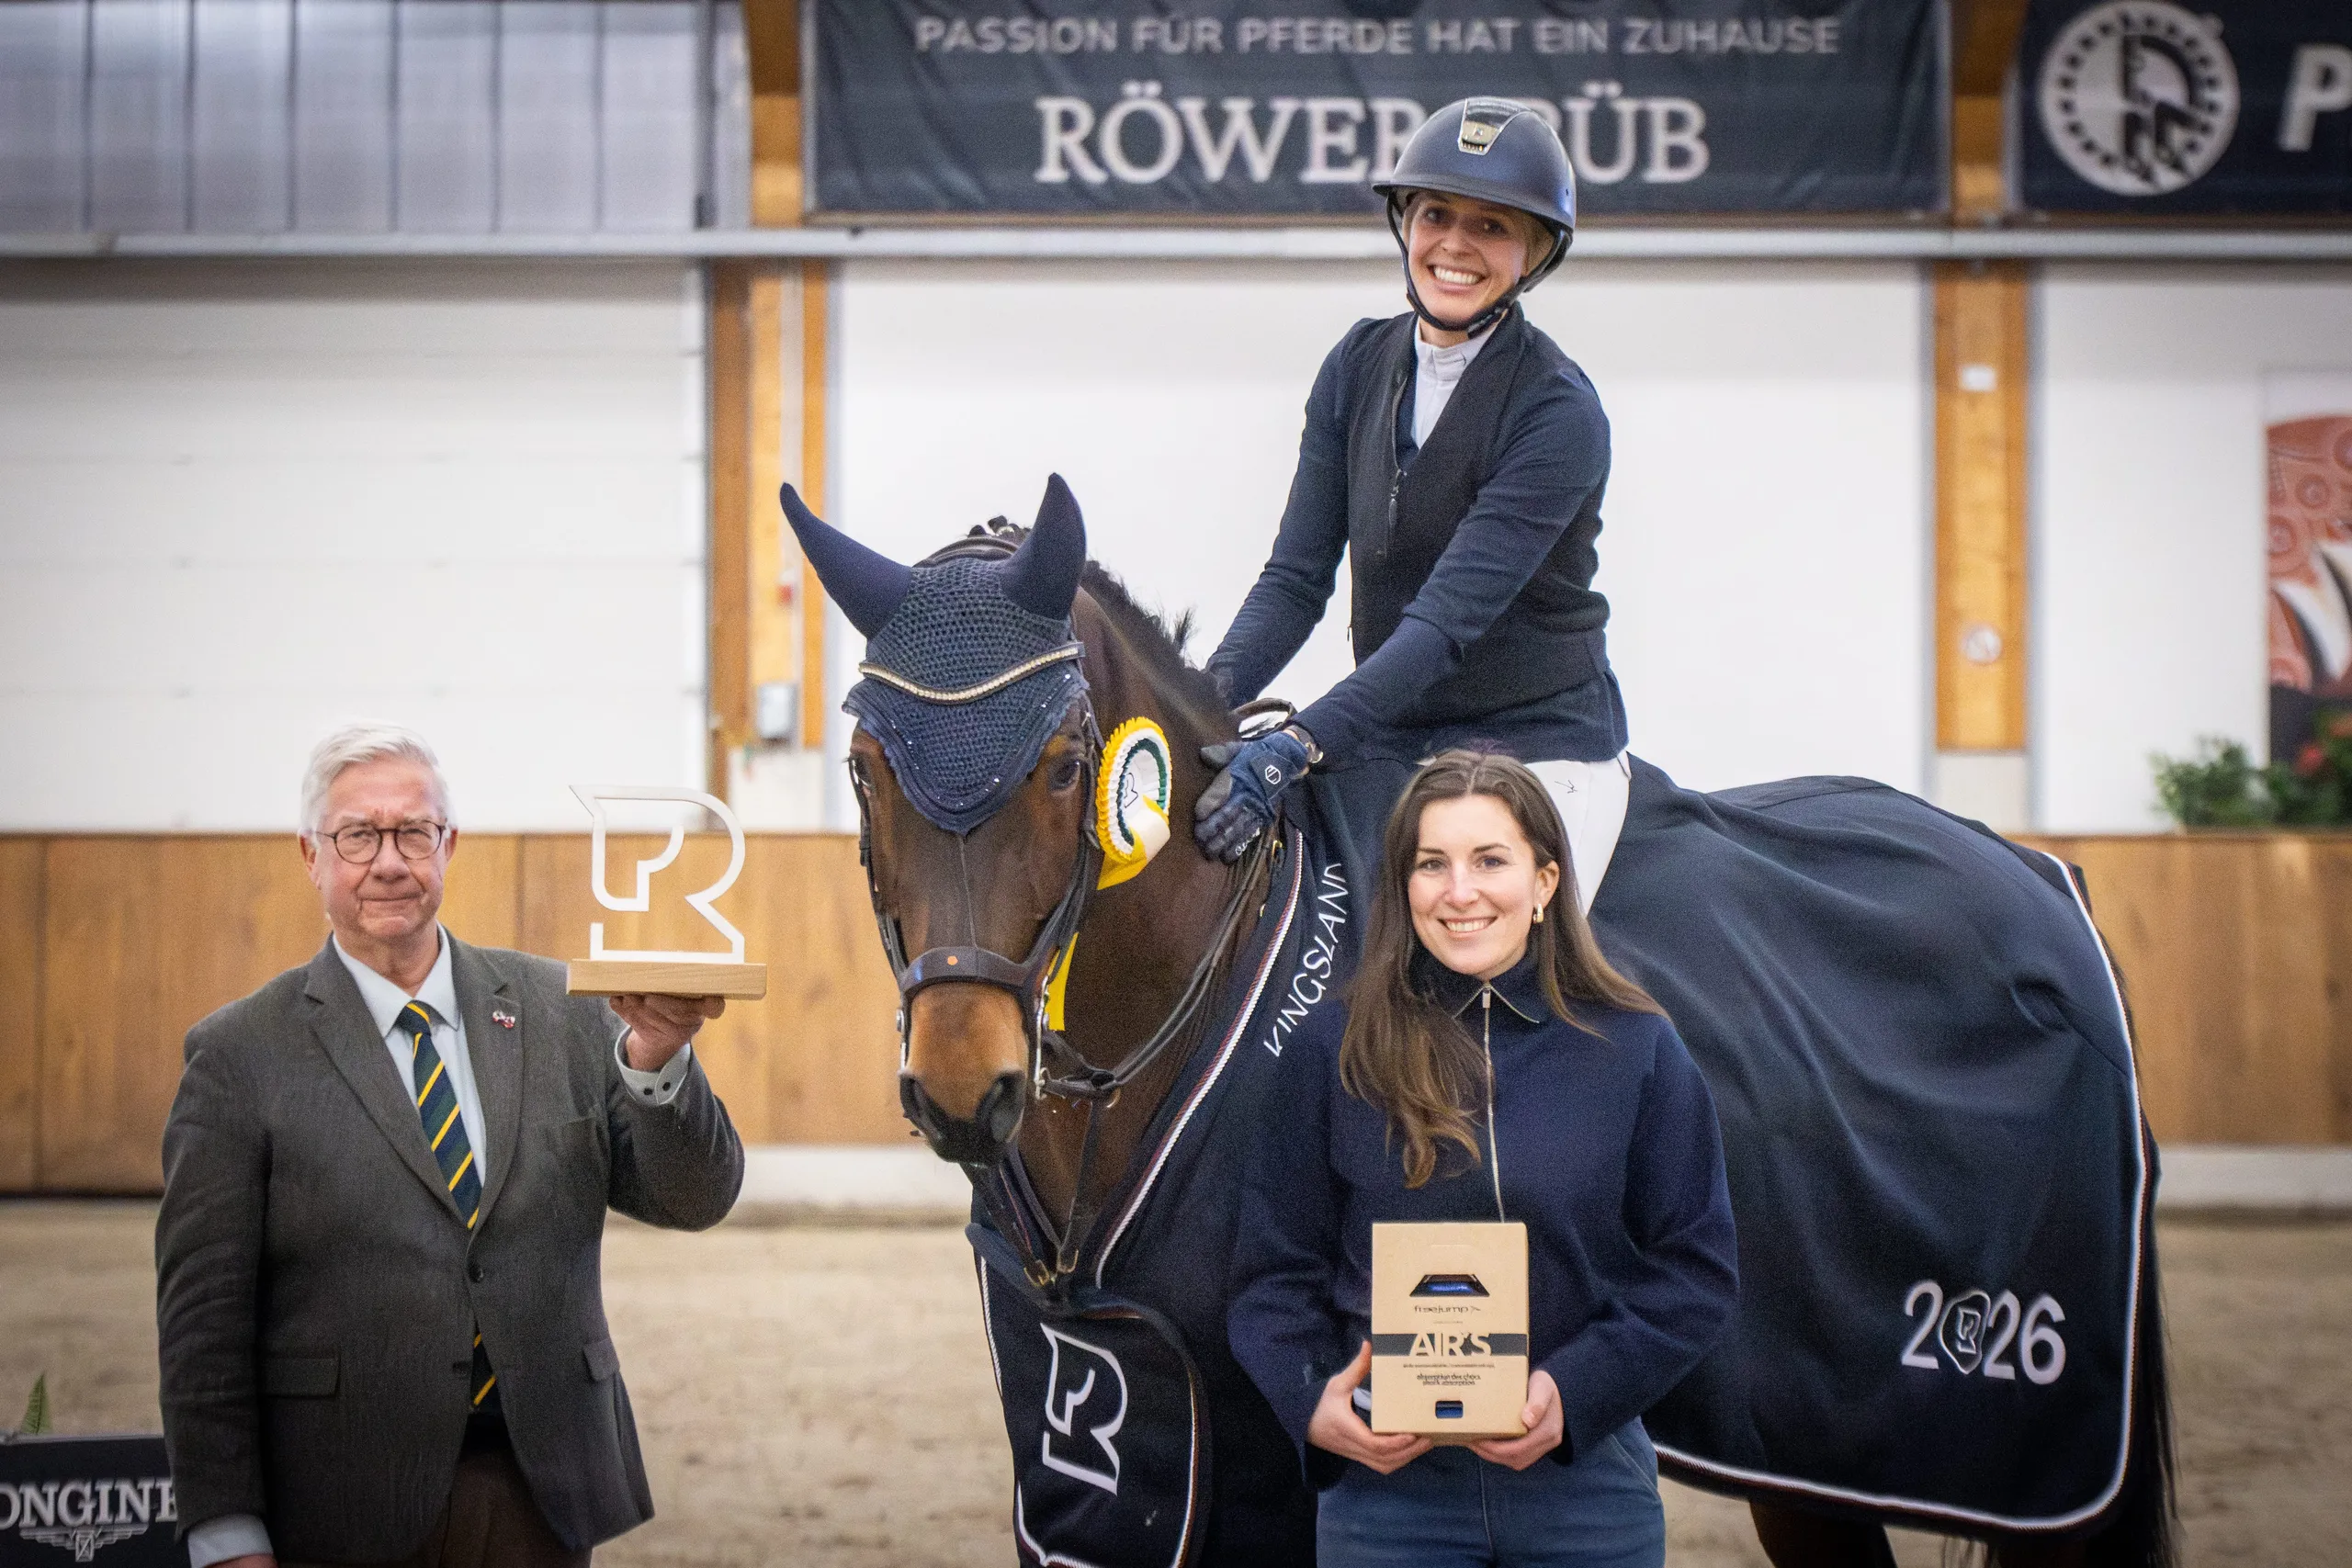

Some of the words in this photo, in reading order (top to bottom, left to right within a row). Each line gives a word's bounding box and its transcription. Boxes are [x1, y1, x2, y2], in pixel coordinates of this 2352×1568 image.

[917, 16, 1118, 54] PASSION
[1131, 10, 1225, 54] FÜR
[1237, 17, 1413, 55] PFERDE
[1427, 17, 1521, 54] HAT
[1533, 17, 1609, 54] EIN
[1623, 17, 1840, 54] ZUHAUSE
[1531, 81, 1710, 184] ÜB
